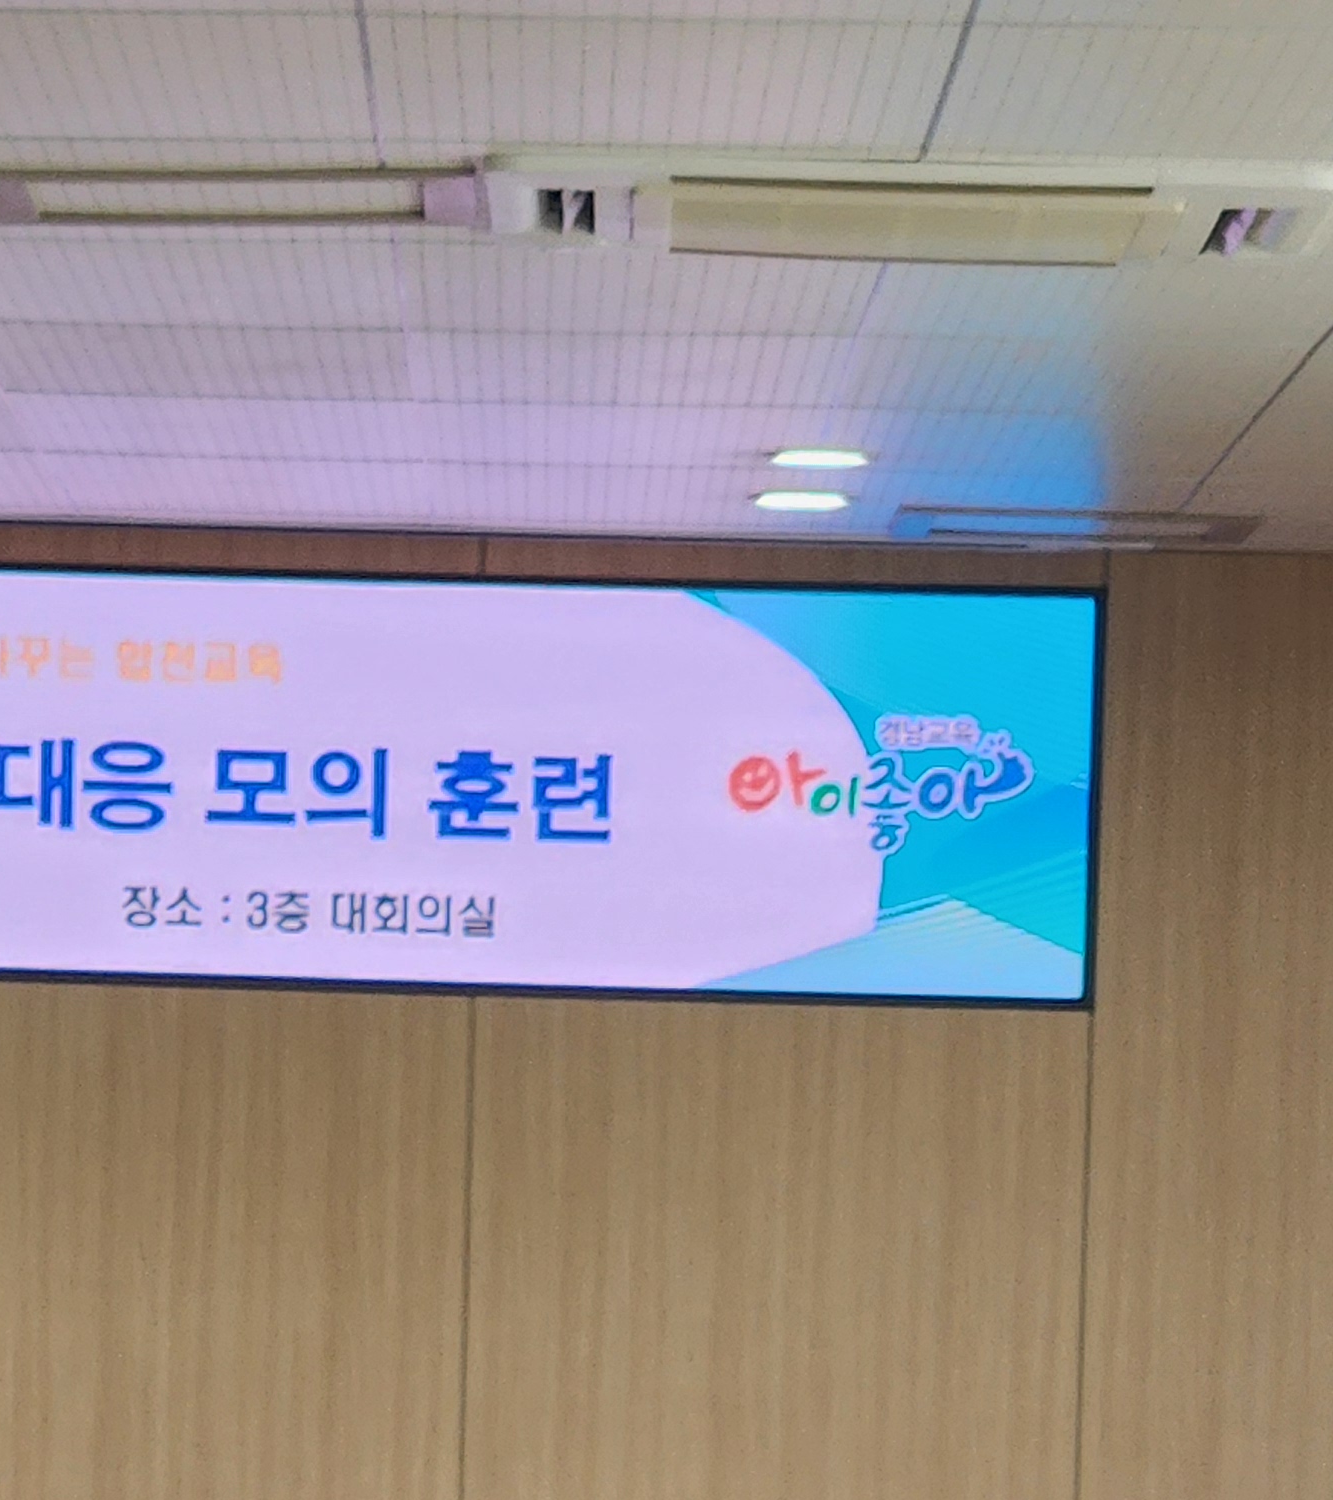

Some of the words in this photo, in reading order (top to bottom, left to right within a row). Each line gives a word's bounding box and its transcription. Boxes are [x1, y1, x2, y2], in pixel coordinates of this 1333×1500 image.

[204, 747, 391, 842] 모의
[428, 750, 614, 846] 훈련
[122, 886, 204, 931] 장소
[331, 892, 498, 941] 대회의실
